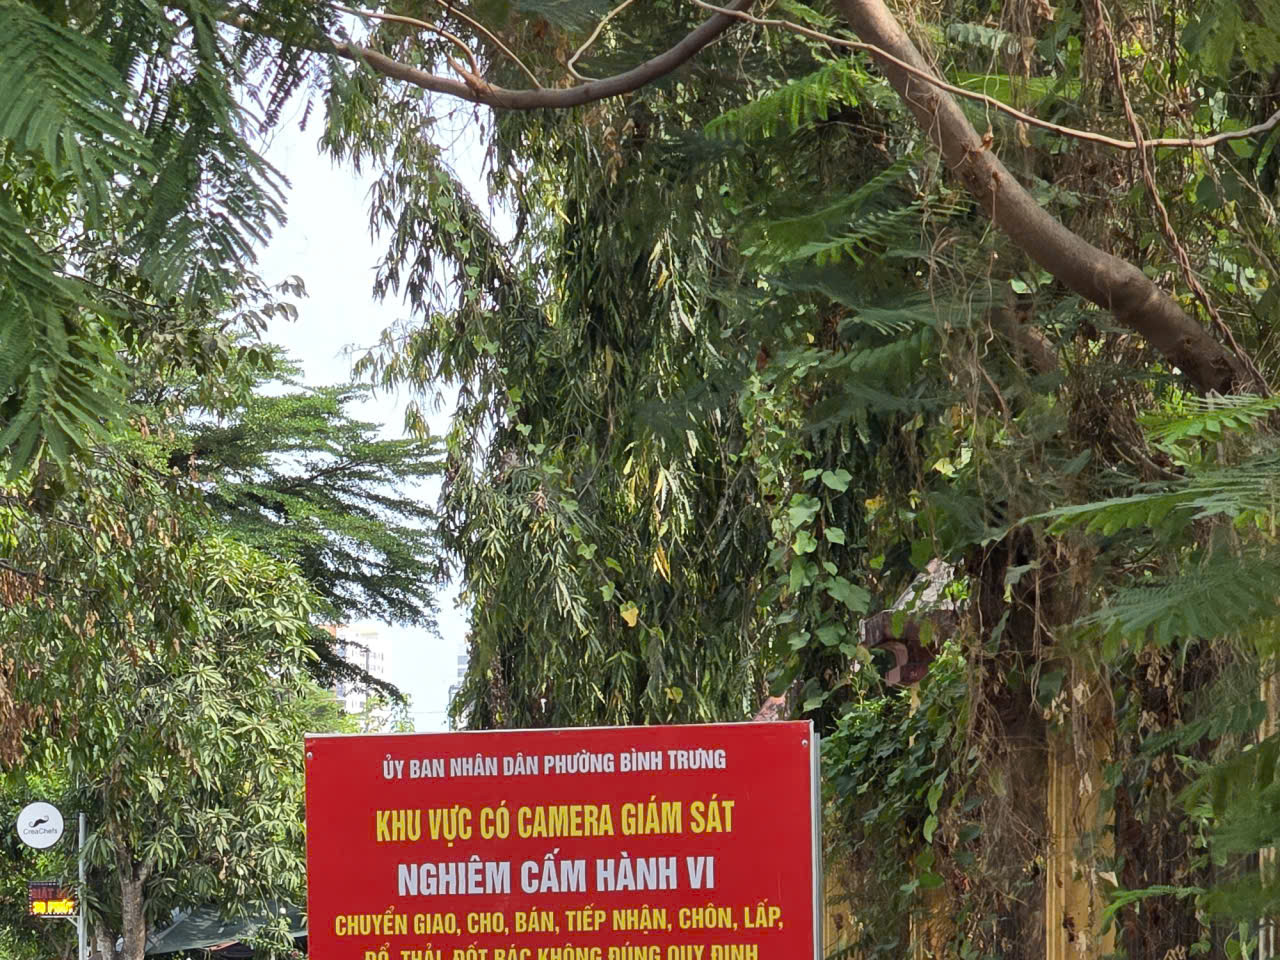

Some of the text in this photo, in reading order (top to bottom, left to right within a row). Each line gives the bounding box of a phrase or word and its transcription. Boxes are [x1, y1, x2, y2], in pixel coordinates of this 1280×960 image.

[383, 748, 726, 779] ỦY BAN NHÂN DÂN PHƯỜNG BÌNH TRƯNG
[377, 794, 734, 847] KHU VỰC CÓ CAMERA GIÁM SÁT
[398, 848, 714, 896] NGHIÊM CẤM HÀNH VI
[336, 899, 783, 936] CHUYỂN GIAO, CHO, BÁN, TIẾP NHẬN, CHÔN, LẤP,
